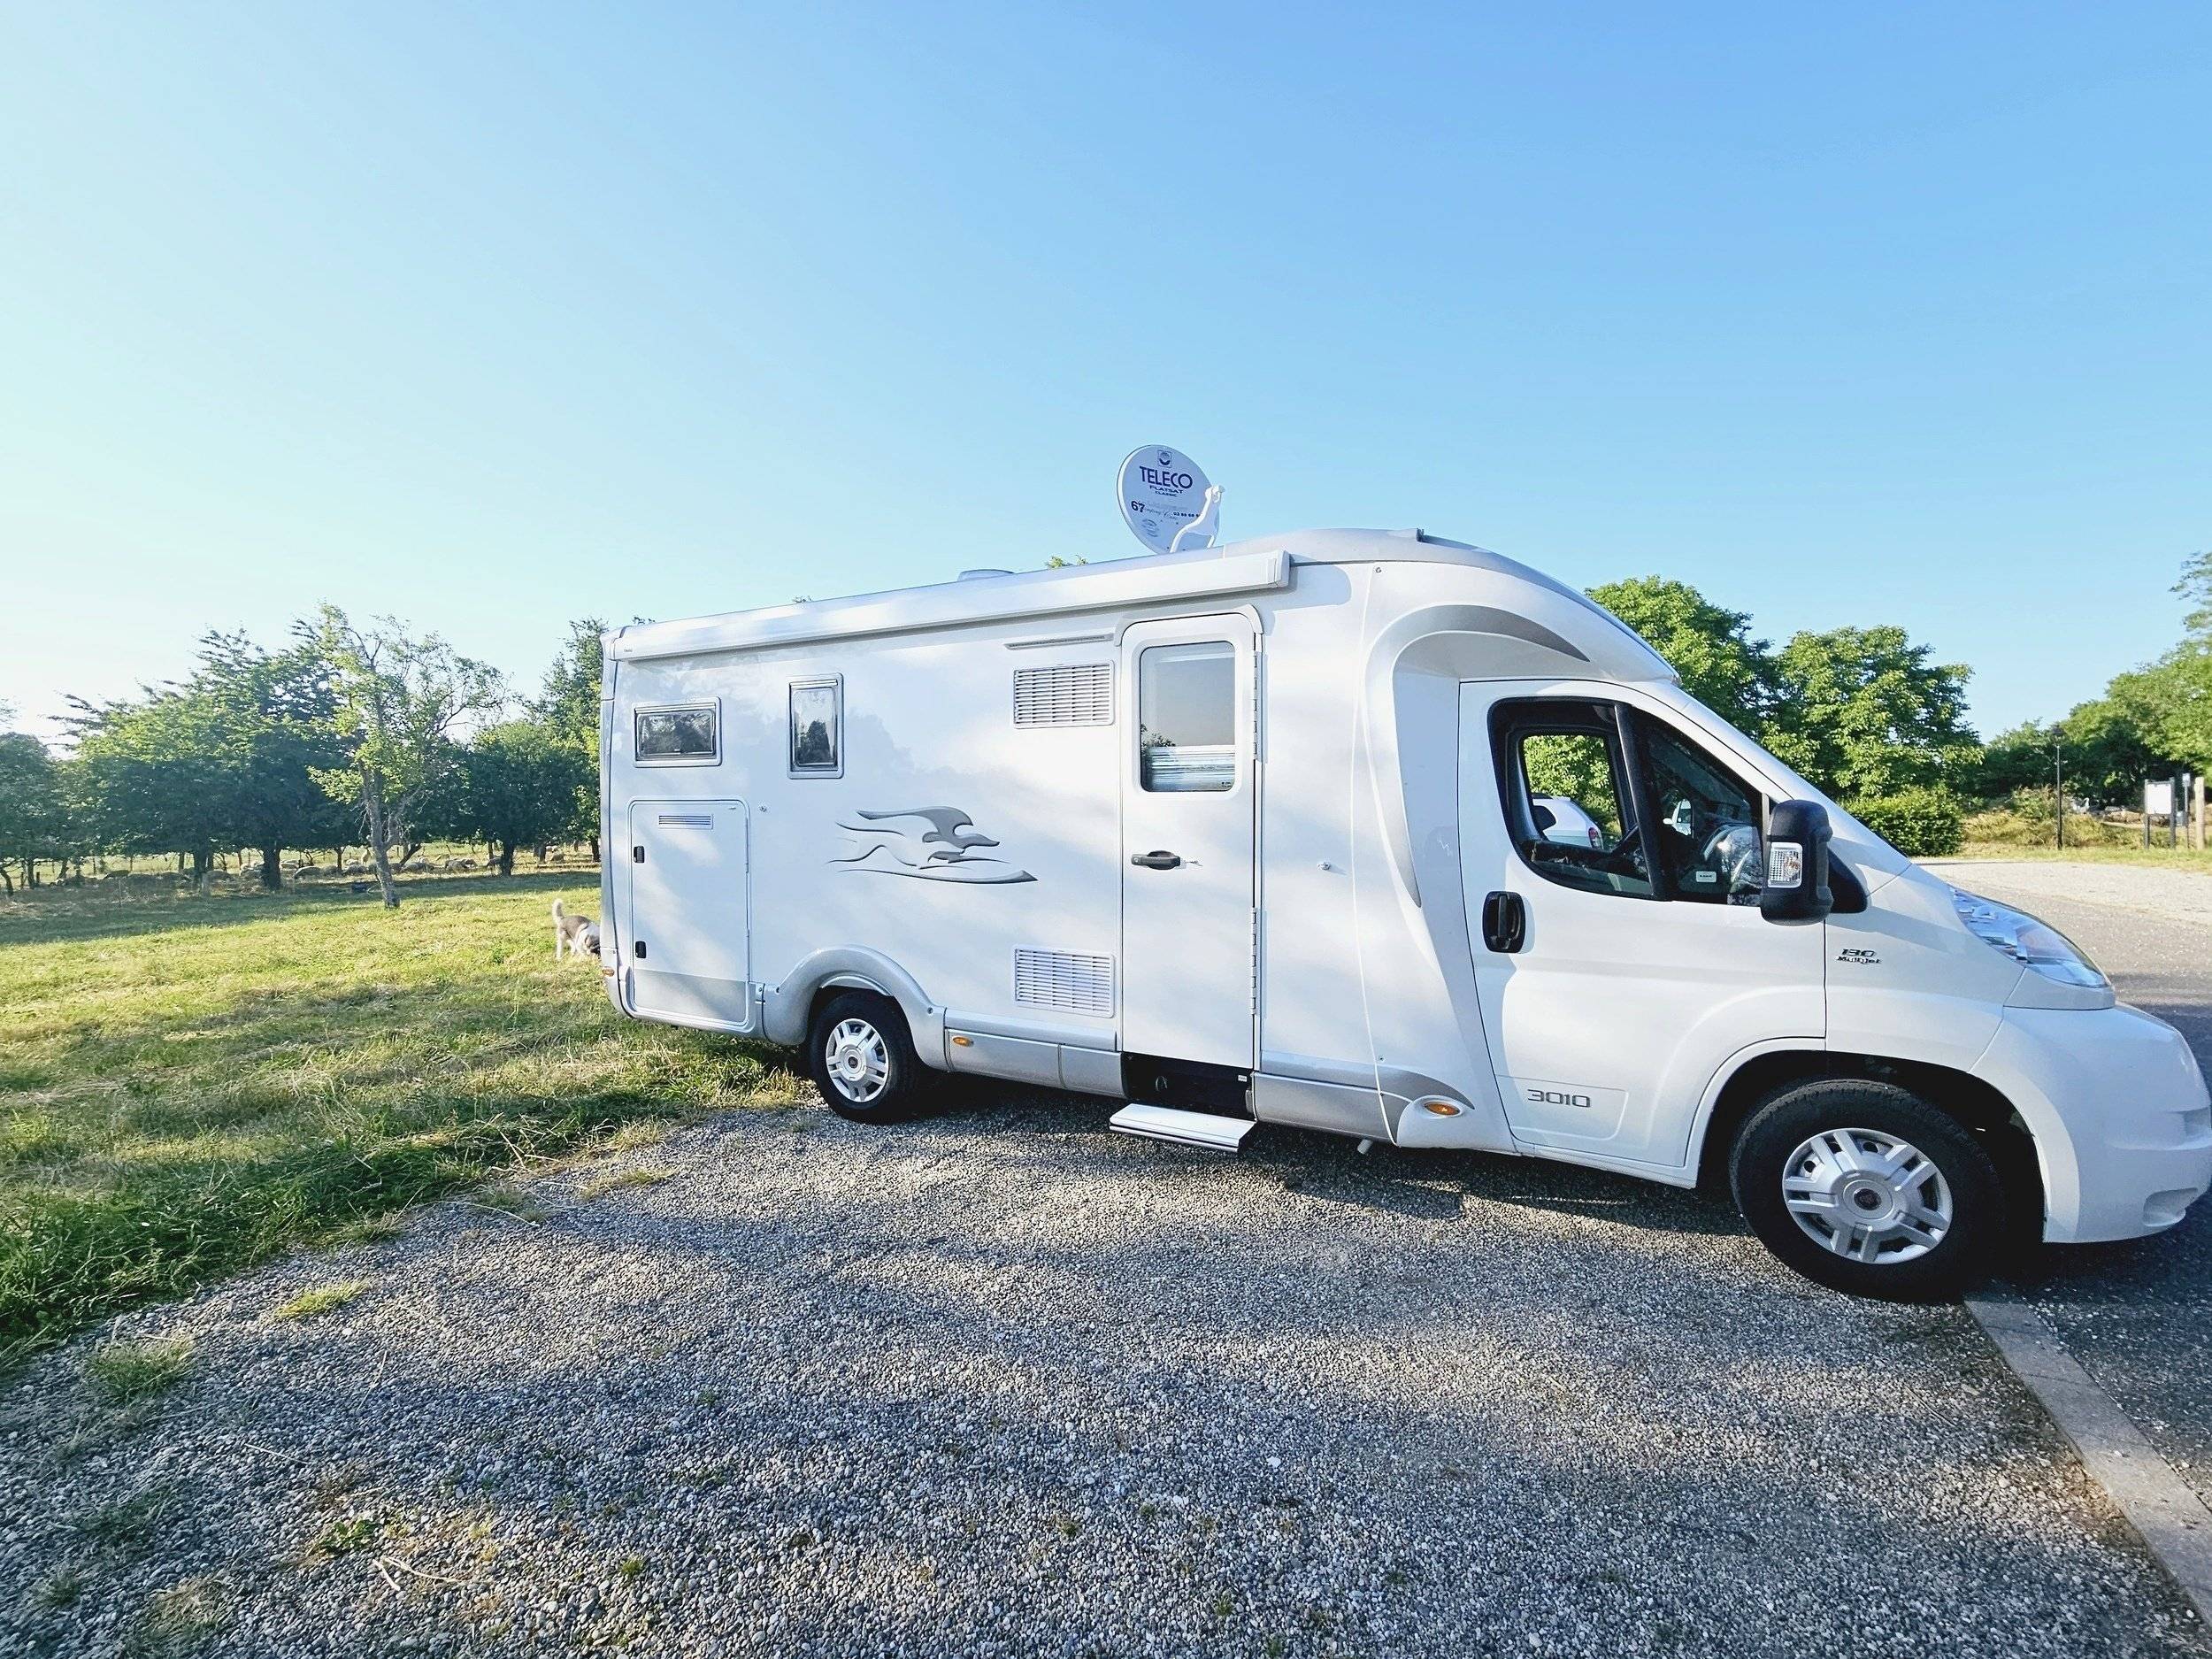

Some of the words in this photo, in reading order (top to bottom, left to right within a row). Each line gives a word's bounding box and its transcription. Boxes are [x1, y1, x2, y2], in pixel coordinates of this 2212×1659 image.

[1140, 465, 1193, 488] TELECO
[1131, 501, 1145, 512] 67
[1841, 949, 1876, 957] 130
[1527, 1088, 1591, 1108] 3010
